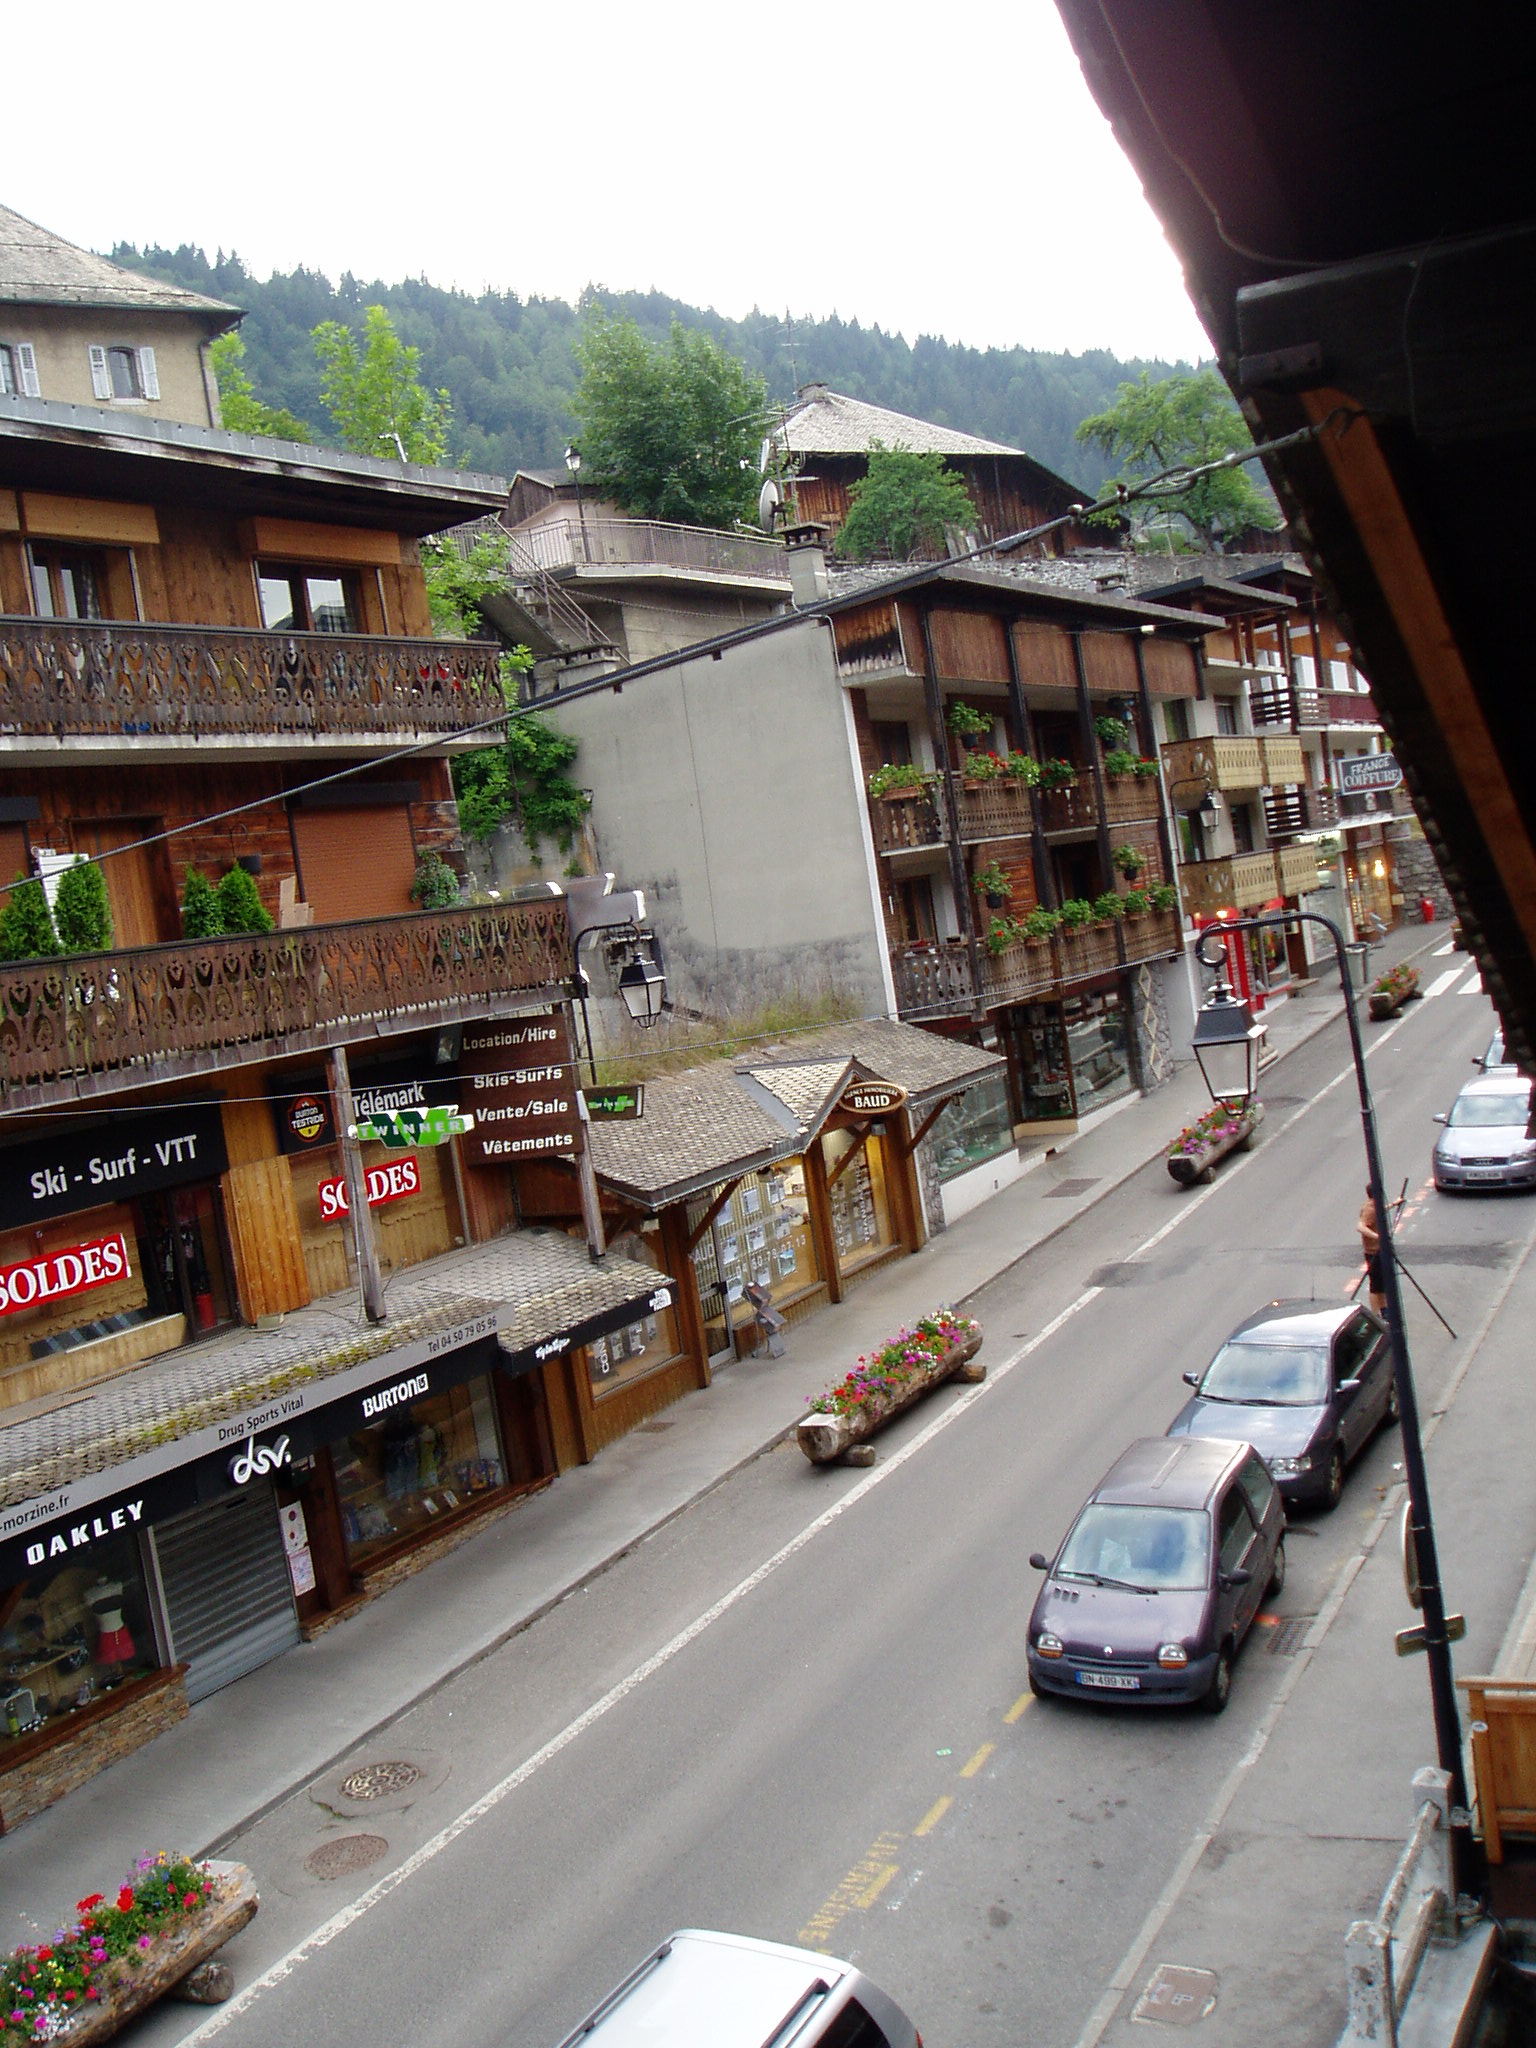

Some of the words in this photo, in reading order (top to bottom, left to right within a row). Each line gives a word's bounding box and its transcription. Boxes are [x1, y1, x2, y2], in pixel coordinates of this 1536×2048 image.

[1345, 769, 1398, 787] COIFFURE
[1351, 757, 1390, 775] FRANCE
[463, 1028, 557, 1050] Location/Hire
[474, 1066, 563, 1089] Skis-Surfs
[352, 1083, 425, 1117] Télémark
[476, 1099, 568, 1122] Vente/Sale
[855, 1095, 890, 1108] BAUD
[483, 1134, 573, 1155] Vêtements
[31, 1165, 67, 1199] Ski
[89, 1148, 136, 1184] Surf
[155, 1134, 197, 1166] VTT
[321, 1161, 417, 1215] SDES
[427, 1339, 440, 1353] Tel
[441, 1335, 452, 1347] 04
[453, 1330, 463, 1343] 50
[465, 1325, 474, 1337] 79
[476, 1320, 486, 1333] 05
[362, 1377, 418, 1418] BURTON
[218, 1423, 244, 1441] Drug
[246, 1408, 279, 1430] Sports
[281, 1395, 304, 1414] Vital
[27, 1500, 143, 1565] OAKLEY
